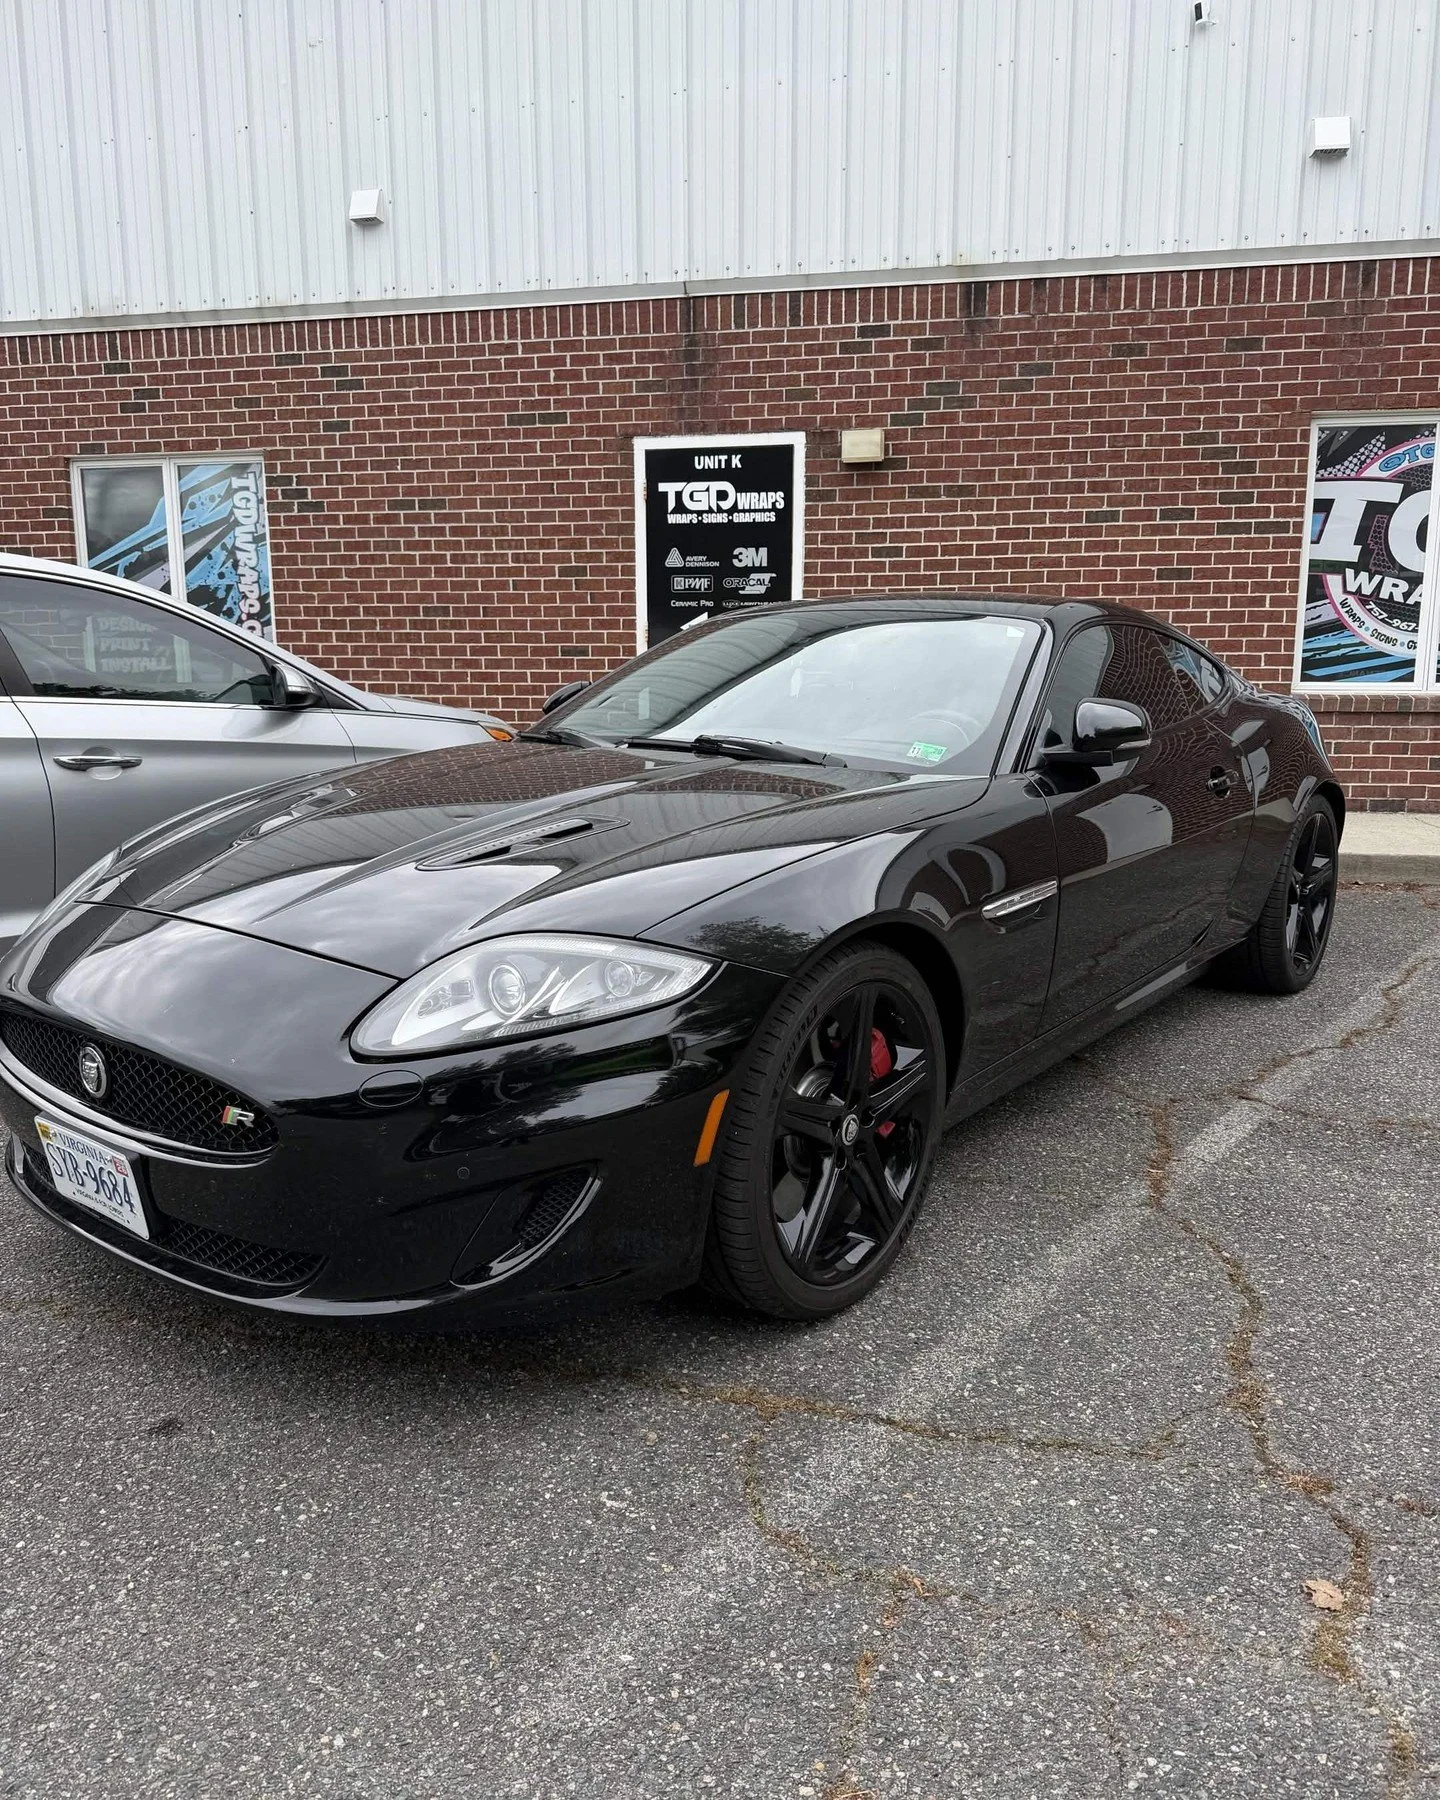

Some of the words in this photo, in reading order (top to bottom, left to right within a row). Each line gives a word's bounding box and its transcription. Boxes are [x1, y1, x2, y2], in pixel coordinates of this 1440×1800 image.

[694, 455, 728, 470] UNIT
[731, 454, 742, 469] K
[658, 481, 736, 513] TGD
[736, 491, 785, 510] WRAPS
[667, 513, 698, 524] WRAPS
[702, 512, 728, 523] SIGNS
[732, 511, 776, 523] GRAPHICS
[732, 547, 768, 567] 3M
[723, 577, 771, 589] ORACAL
[1339, 597, 1365, 629] WRAPS
[1370, 628, 1398, 647] SIGNS
[59, 1132, 107, 1165] VIRGINIA
[46, 1142, 137, 1216] SYB-9684
